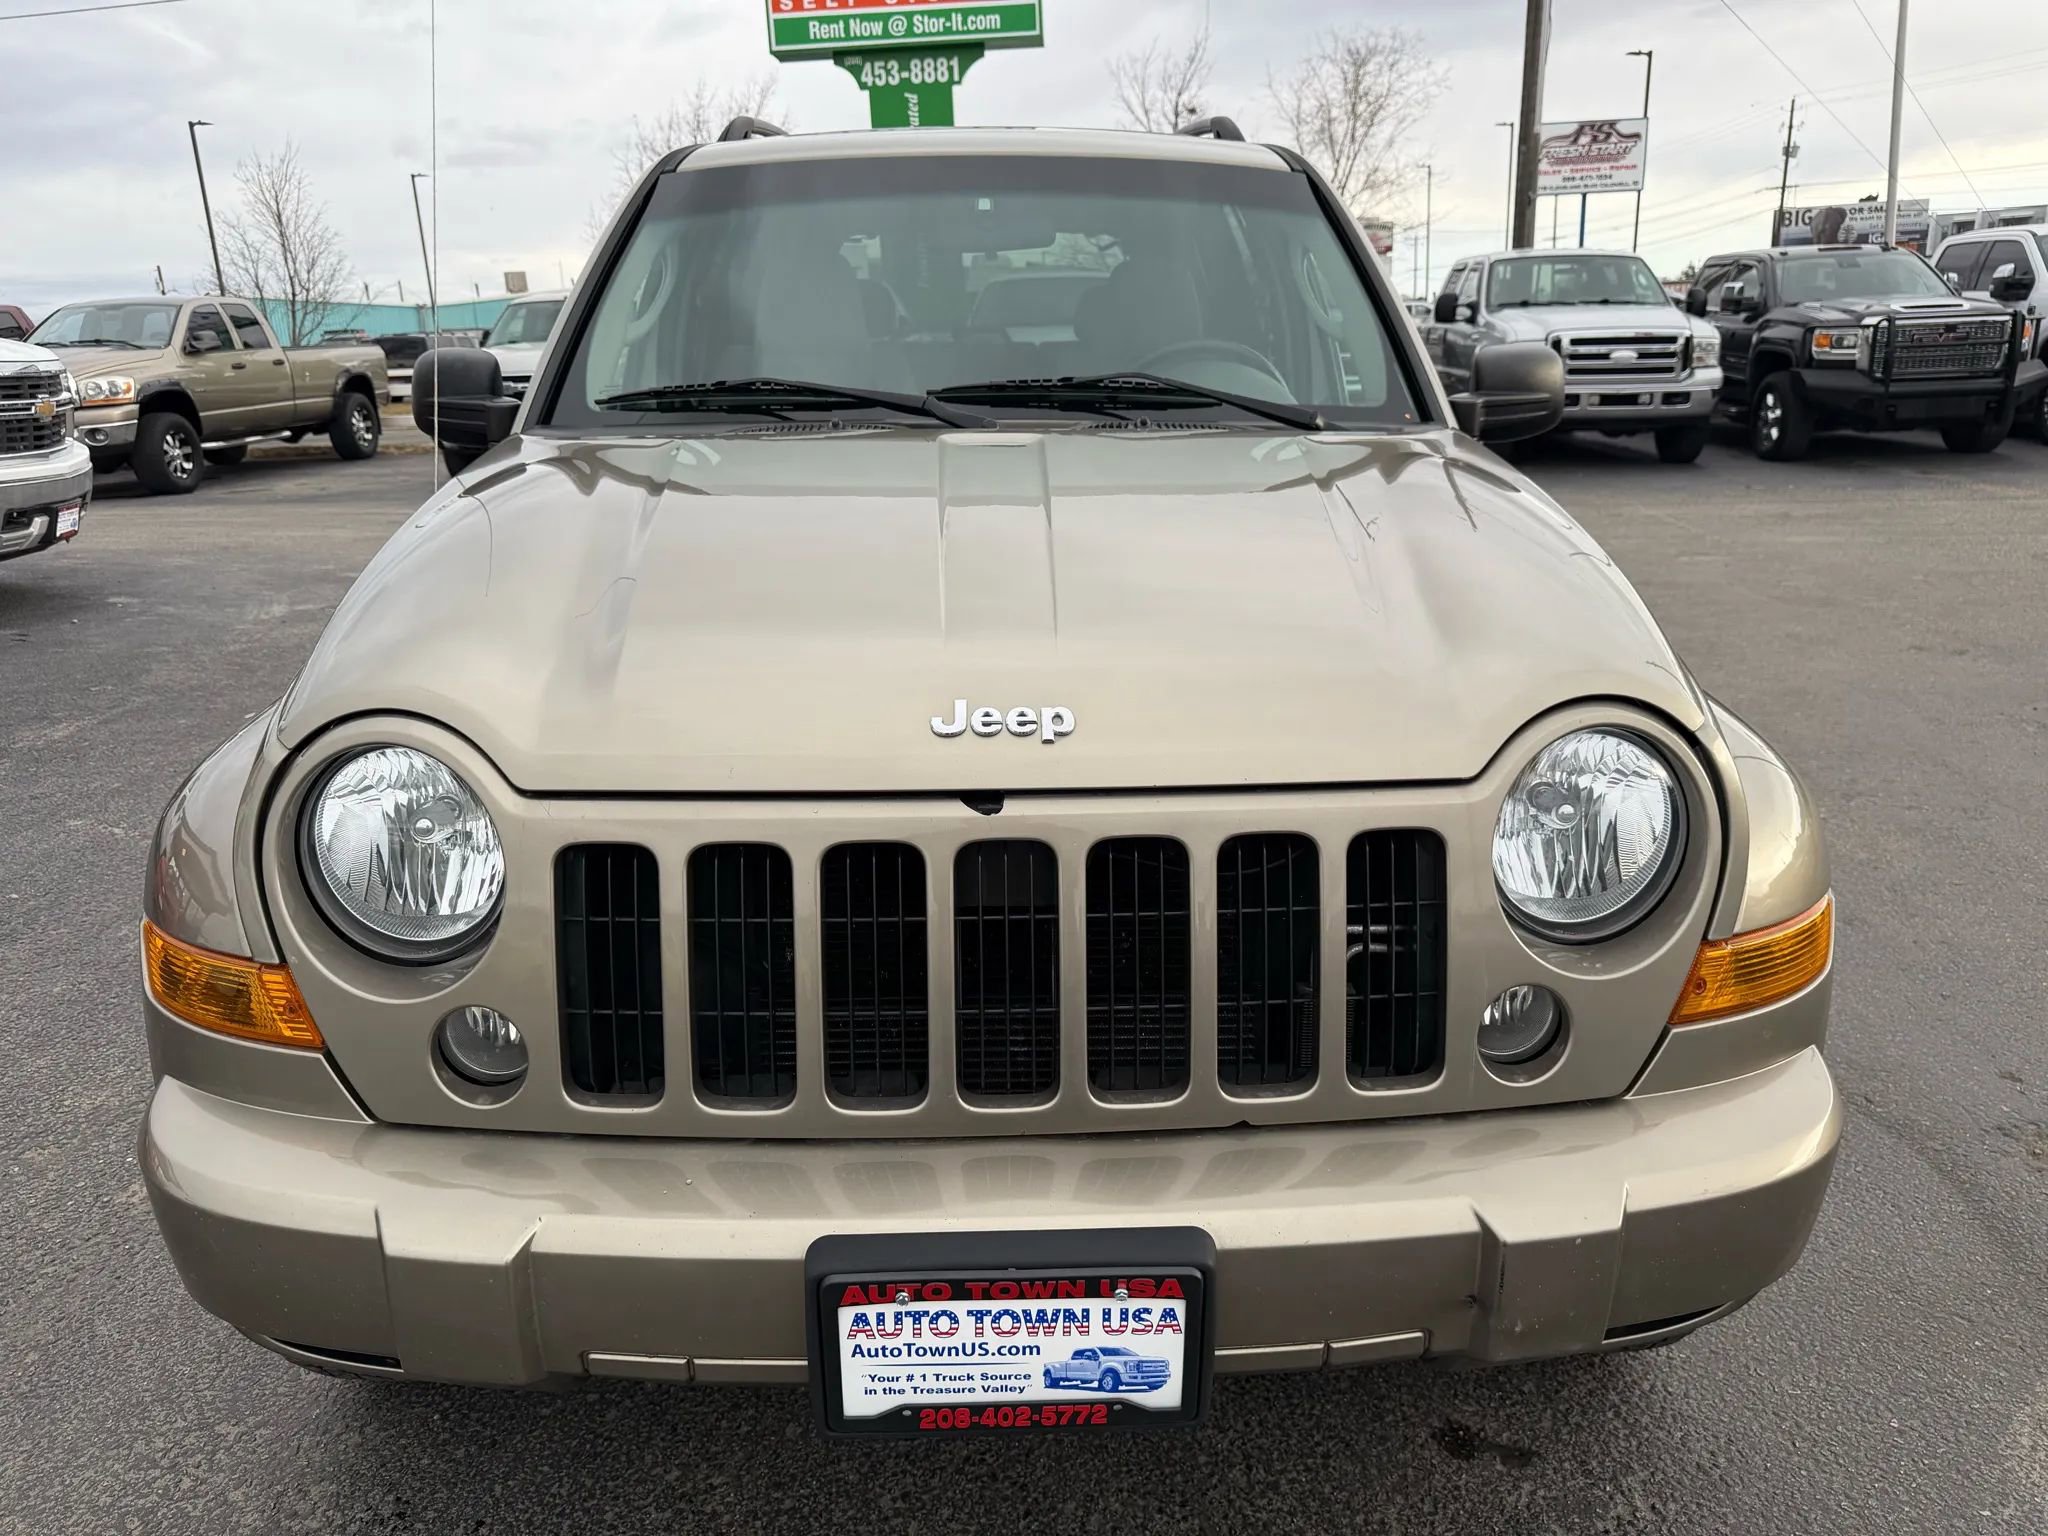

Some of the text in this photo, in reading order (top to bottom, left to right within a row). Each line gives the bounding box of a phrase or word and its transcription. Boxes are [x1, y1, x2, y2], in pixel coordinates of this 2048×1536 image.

[809, 13, 1001, 39] Rent Now @ Stor-It.com
[861, 56, 960, 87] 453-8881
[1782, 209, 1813, 228] BIG
[1849, 206, 1866, 216] OR
[930, 699, 1076, 744] Jeep
[840, 1278, 1184, 1306] AUTO TOWN USA
[847, 1307, 1183, 1340] AUTO TOWN USA
[851, 1342, 1041, 1359] AutoTownUS.com
[906, 1373, 915, 1382] #
[920, 1373, 927, 1382] 1
[933, 1372, 975, 1382] Truck
[980, 1372, 1032, 1381] Source
[864, 1386, 877, 1395] in
[882, 1386, 906, 1395] the
[911, 1385, 976, 1395] Treasure
[919, 1404, 1108, 1429] 208-402-5772
